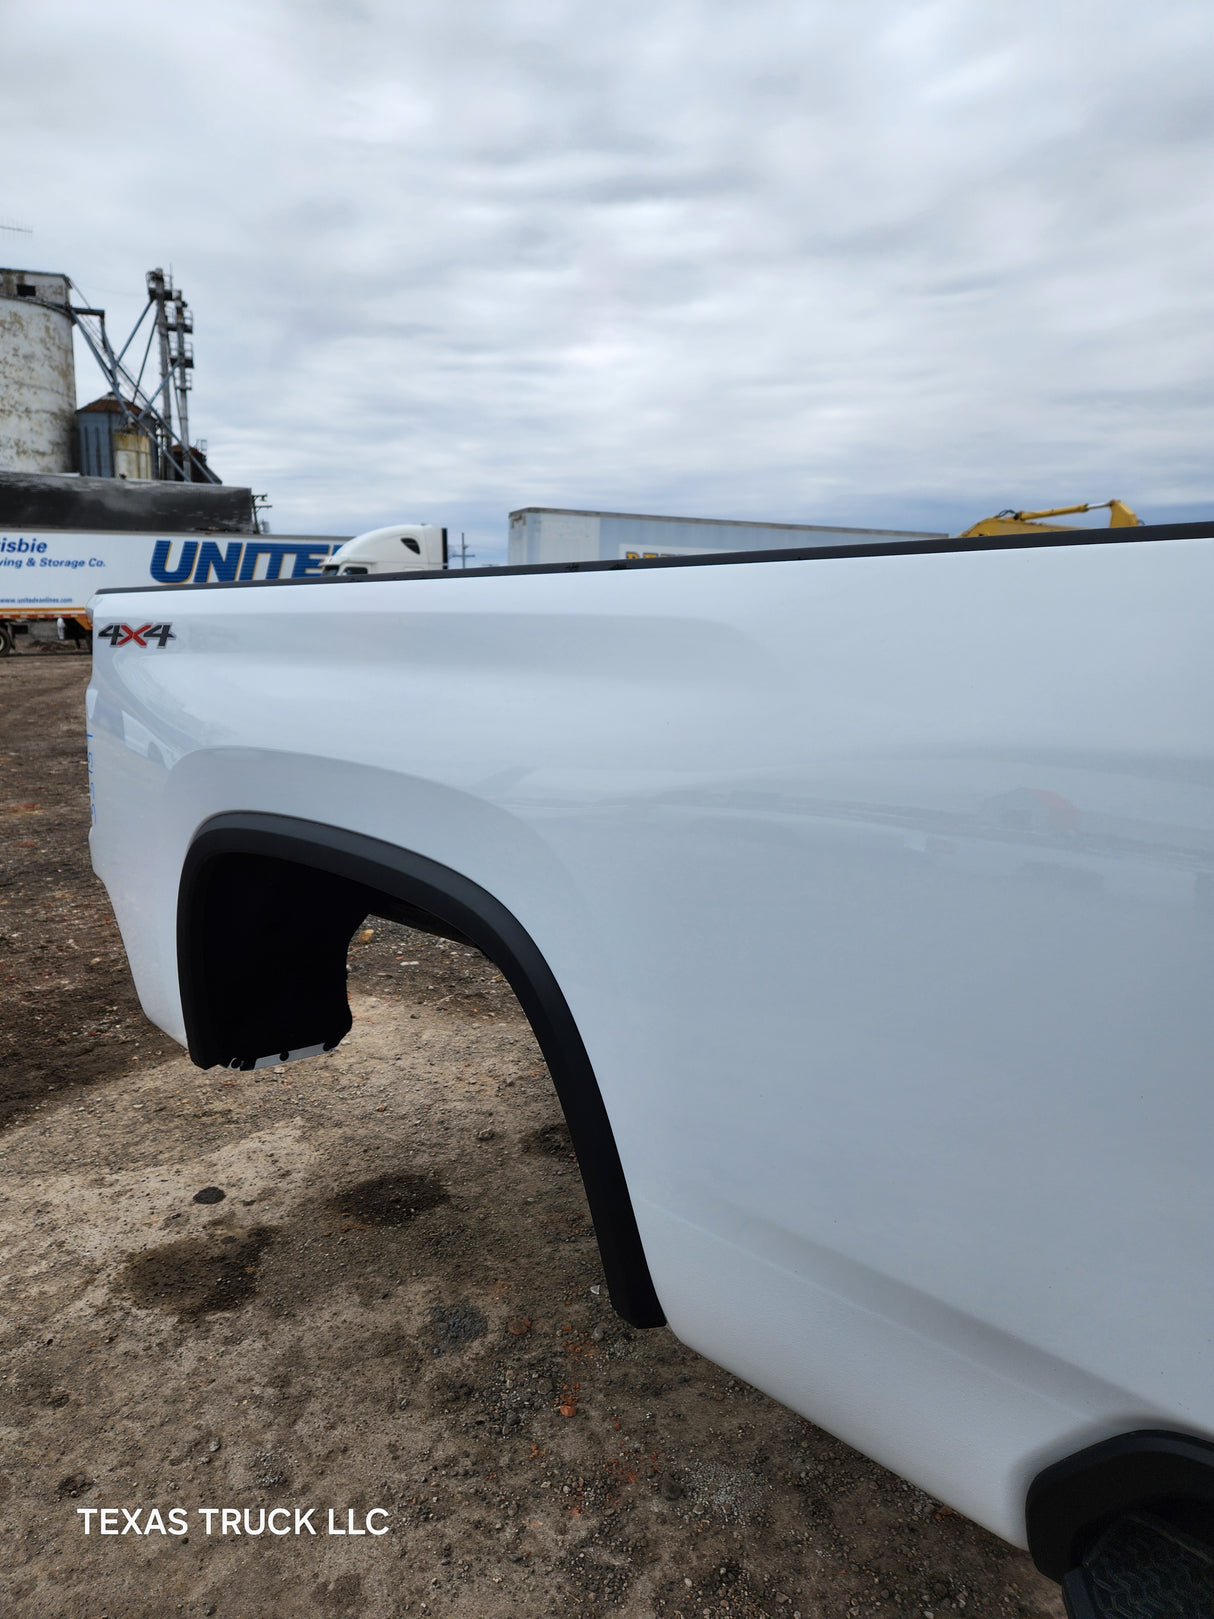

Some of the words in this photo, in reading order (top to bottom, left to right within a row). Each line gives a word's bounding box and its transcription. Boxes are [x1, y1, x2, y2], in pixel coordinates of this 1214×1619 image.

[0, 537, 47, 553] isbie
[26, 557, 36, 567] &
[39, 557, 86, 570] Storage
[88, 557, 106, 568] Co.
[150, 540, 342, 585] UNITE
